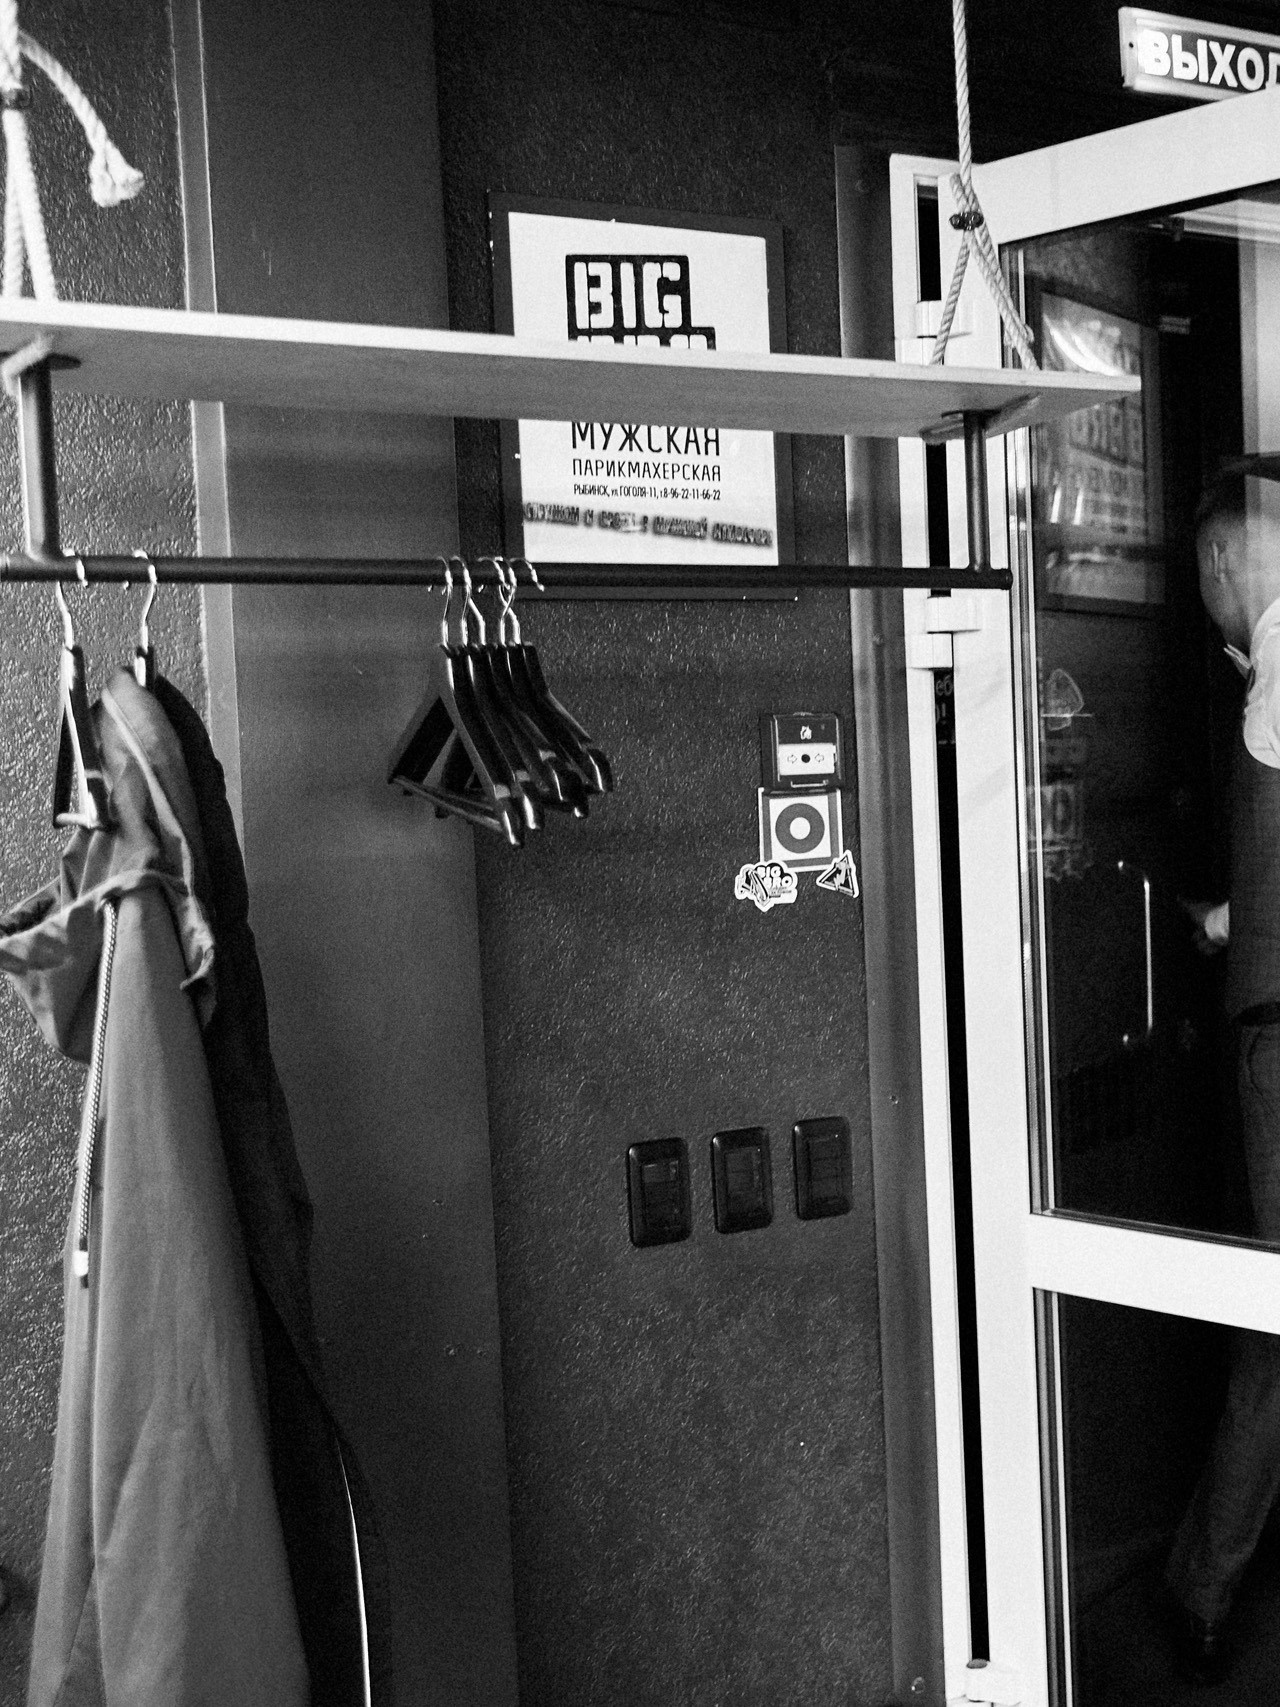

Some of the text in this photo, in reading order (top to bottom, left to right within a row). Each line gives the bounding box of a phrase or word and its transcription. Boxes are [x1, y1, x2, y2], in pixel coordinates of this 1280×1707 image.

[571, 259, 684, 330] BIG
[571, 421, 720, 456] МУЖСКАЯ
[572, 458, 721, 482] ПАРИКМАХЕРСКАЯ
